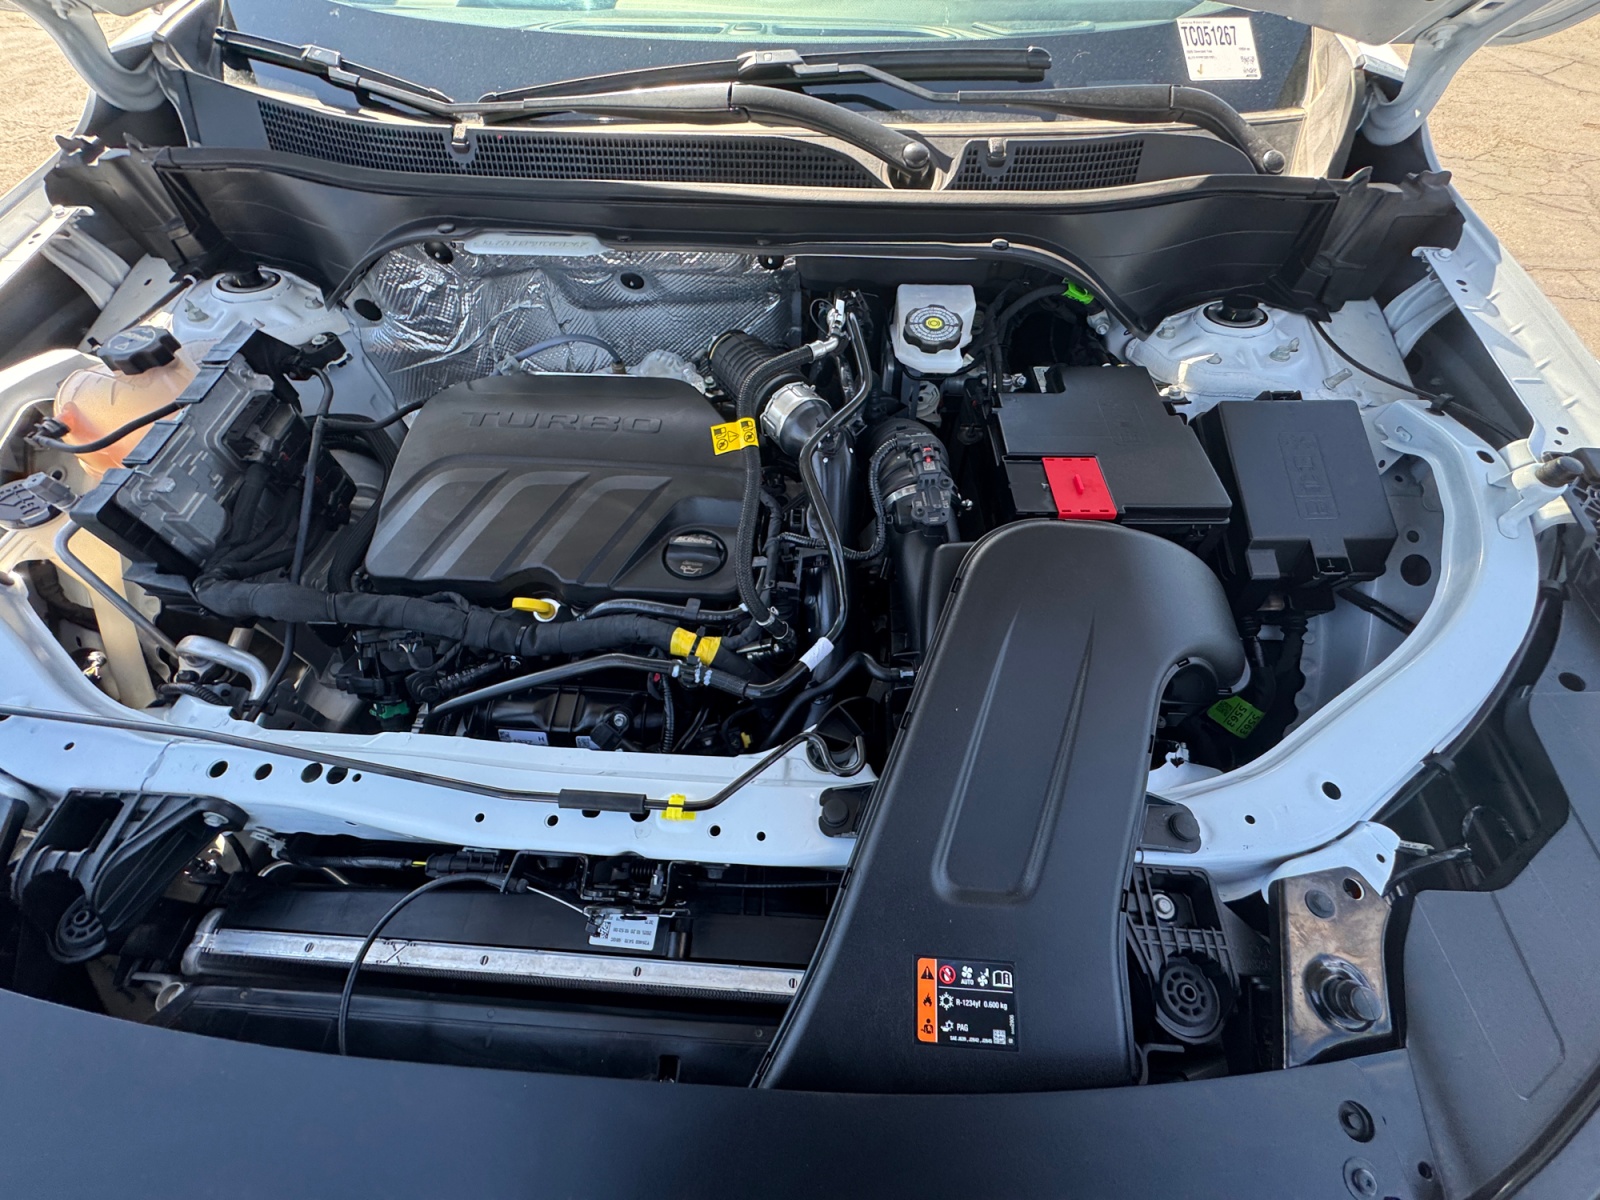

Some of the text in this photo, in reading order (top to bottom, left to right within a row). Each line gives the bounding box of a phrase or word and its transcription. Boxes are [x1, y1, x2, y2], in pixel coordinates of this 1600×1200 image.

[1180, 26, 1237, 46] TC051267
[461, 411, 663, 434] TURBO
[1226, 705, 1248, 728] 5563
[956, 998, 1008, 1011] R-1234yf 0.600 kg
[956, 1023, 969, 1032] PAG
